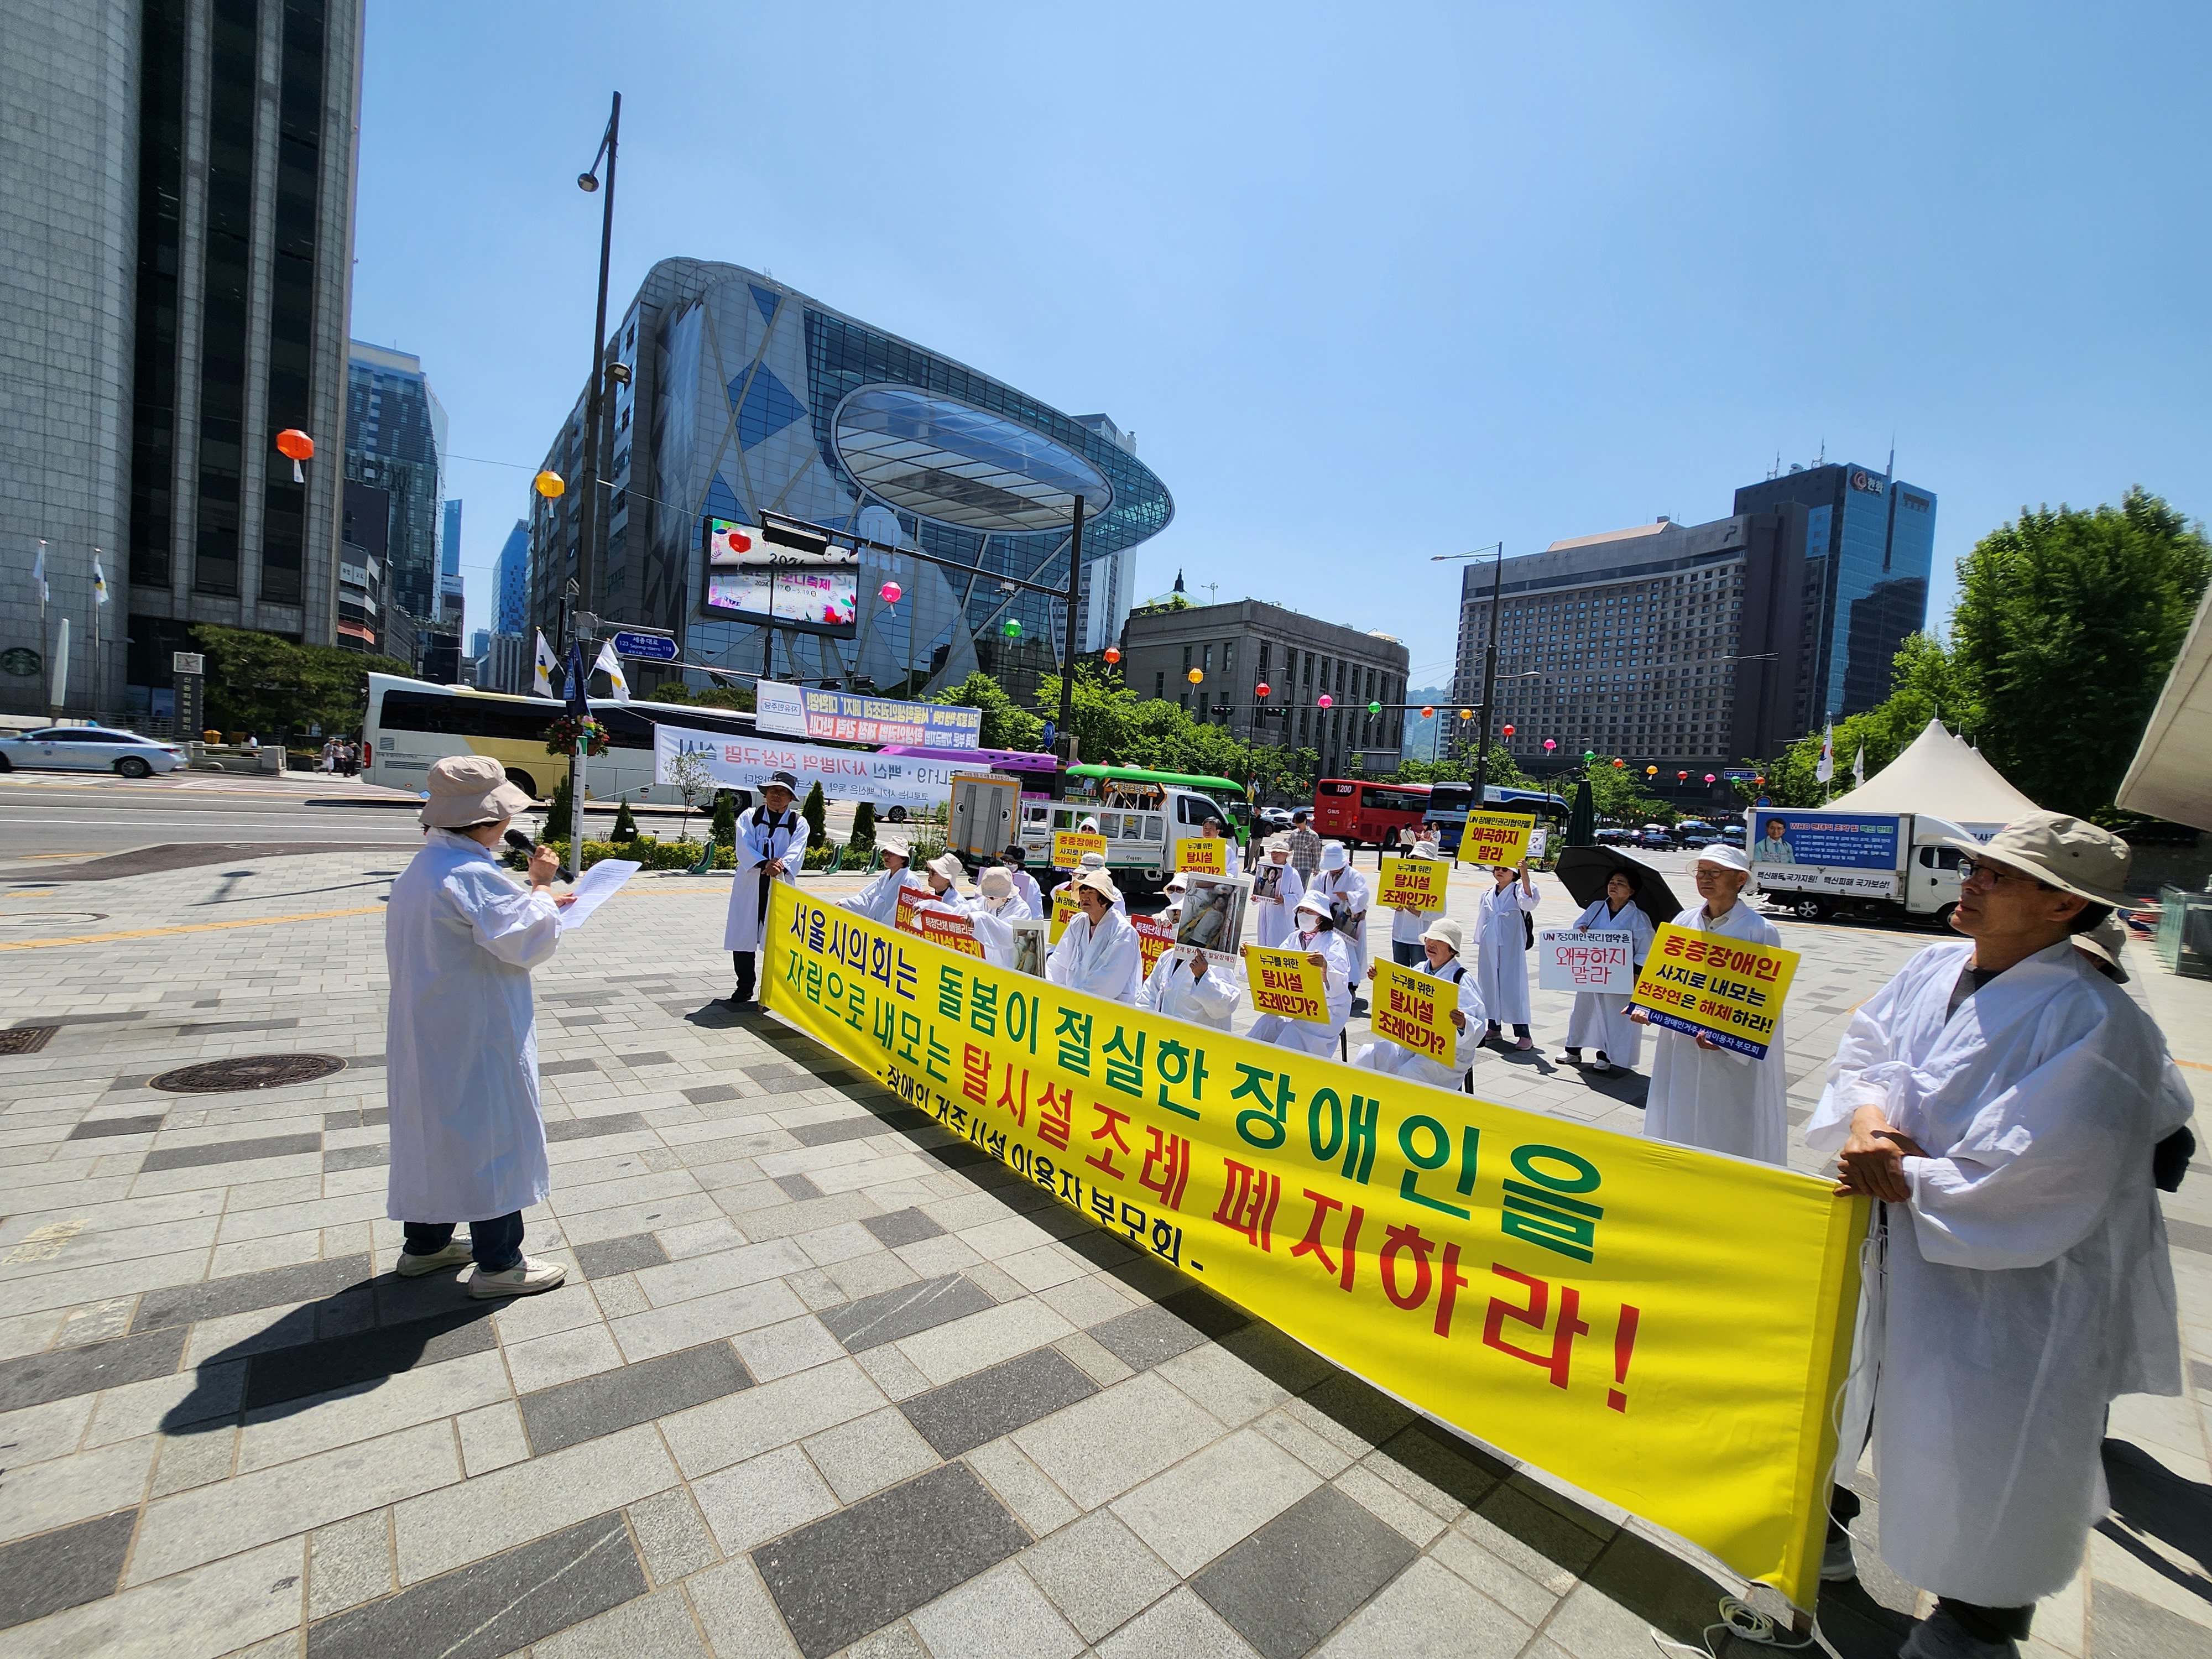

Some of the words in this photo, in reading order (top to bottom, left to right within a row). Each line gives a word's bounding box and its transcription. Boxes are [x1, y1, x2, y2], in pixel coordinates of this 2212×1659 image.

[1867, 477, 1884, 494] 한화
[630, 643, 661, 651] Sejong-daero
[632, 637, 659, 645] 세종대로
[1119, 782, 1145, 794] 공무수행중
[1337, 785, 1352, 793] 1200
[1479, 817, 1531, 828] 장애인권리협약을
[1860, 825, 1876, 833] 백신
[1876, 826, 1894, 834] 반대
[1060, 836, 1102, 848] 중증장애인
[1471, 827, 1520, 846] 왜곡하지
[1060, 848, 1078, 856] 사지로
[1187, 852, 1213, 863] 탈시설
[1478, 846, 1504, 862] 말라
[1397, 864, 1417, 872] 누구를
[1418, 865, 1432, 874] 위한
[1395, 874, 1431, 890] 탈시설
[1757, 871, 1786, 880] 백신해독
[1786, 873, 1818, 883] 국가지원!
[1823, 876, 1854, 886] 백신피해
[1855, 878, 1890, 889] 국가보상!
[1383, 889, 1438, 907] 조례인가?
[925, 916, 948, 932] 특정단체
[948, 921, 975, 936] 배불리는
[1135, 922, 1161, 937] 특정단체
[924, 931, 955, 948] 탈시설
[956, 938, 982, 959] 조례
[1139, 936, 1165, 957] 시설
[1556, 932, 1630, 943] 장애인권리협약을
[1187, 947, 1207, 958] 탈시된
[1208, 952, 1235, 963] 발달장애인
[1260, 954, 1282, 967] 누구를
[1283, 957, 1299, 969] 위한
[1556, 946, 1626, 966] 왜곡하지
[1663, 935, 1782, 983] 중증장애인
[1261, 969, 1303, 993] 탈시설
[1572, 966, 1612, 984] 말라
[1391, 972, 1415, 991] 누구를
[1417, 982, 1435, 998] 위한
[1656, 963, 1707, 990] 사지로
[1709, 977, 1766, 1008] 내모는
[1257, 990, 1319, 1016] 조례인가?
[1390, 988, 1433, 1025] 탈시설
[1637, 980, 1697, 1010] 전장연은
[1699, 999, 1773, 1034] 해체하라!
[1379, 1010, 1446, 1055] 조례인가?
[1650, 1011, 1663, 1023] (사)
[1735, 1040, 1760, 1055] 부모회
[791, 902, 919, 1001] 서울시의회는
[938, 964, 1039, 1055] 돌봄이
[1055, 1006, 1209, 1121] 절실한
[1230, 1062, 1604, 1265] 장애인을
[887, 1063, 930, 1109] 장애인
[935, 1093, 1006, 1161] 거주시설
[1011, 1144, 1083, 1211] 이용자
[1091, 1186, 1182, 1267] 부모회
[786, 948, 867, 1031] 자립으로
[874, 997, 951, 1084] 내모는
[962, 1042, 1074, 1152] 탈시설
[1085, 1102, 1191, 1212] 조례
[1212, 1157, 1641, 1414] 폐지하라!
